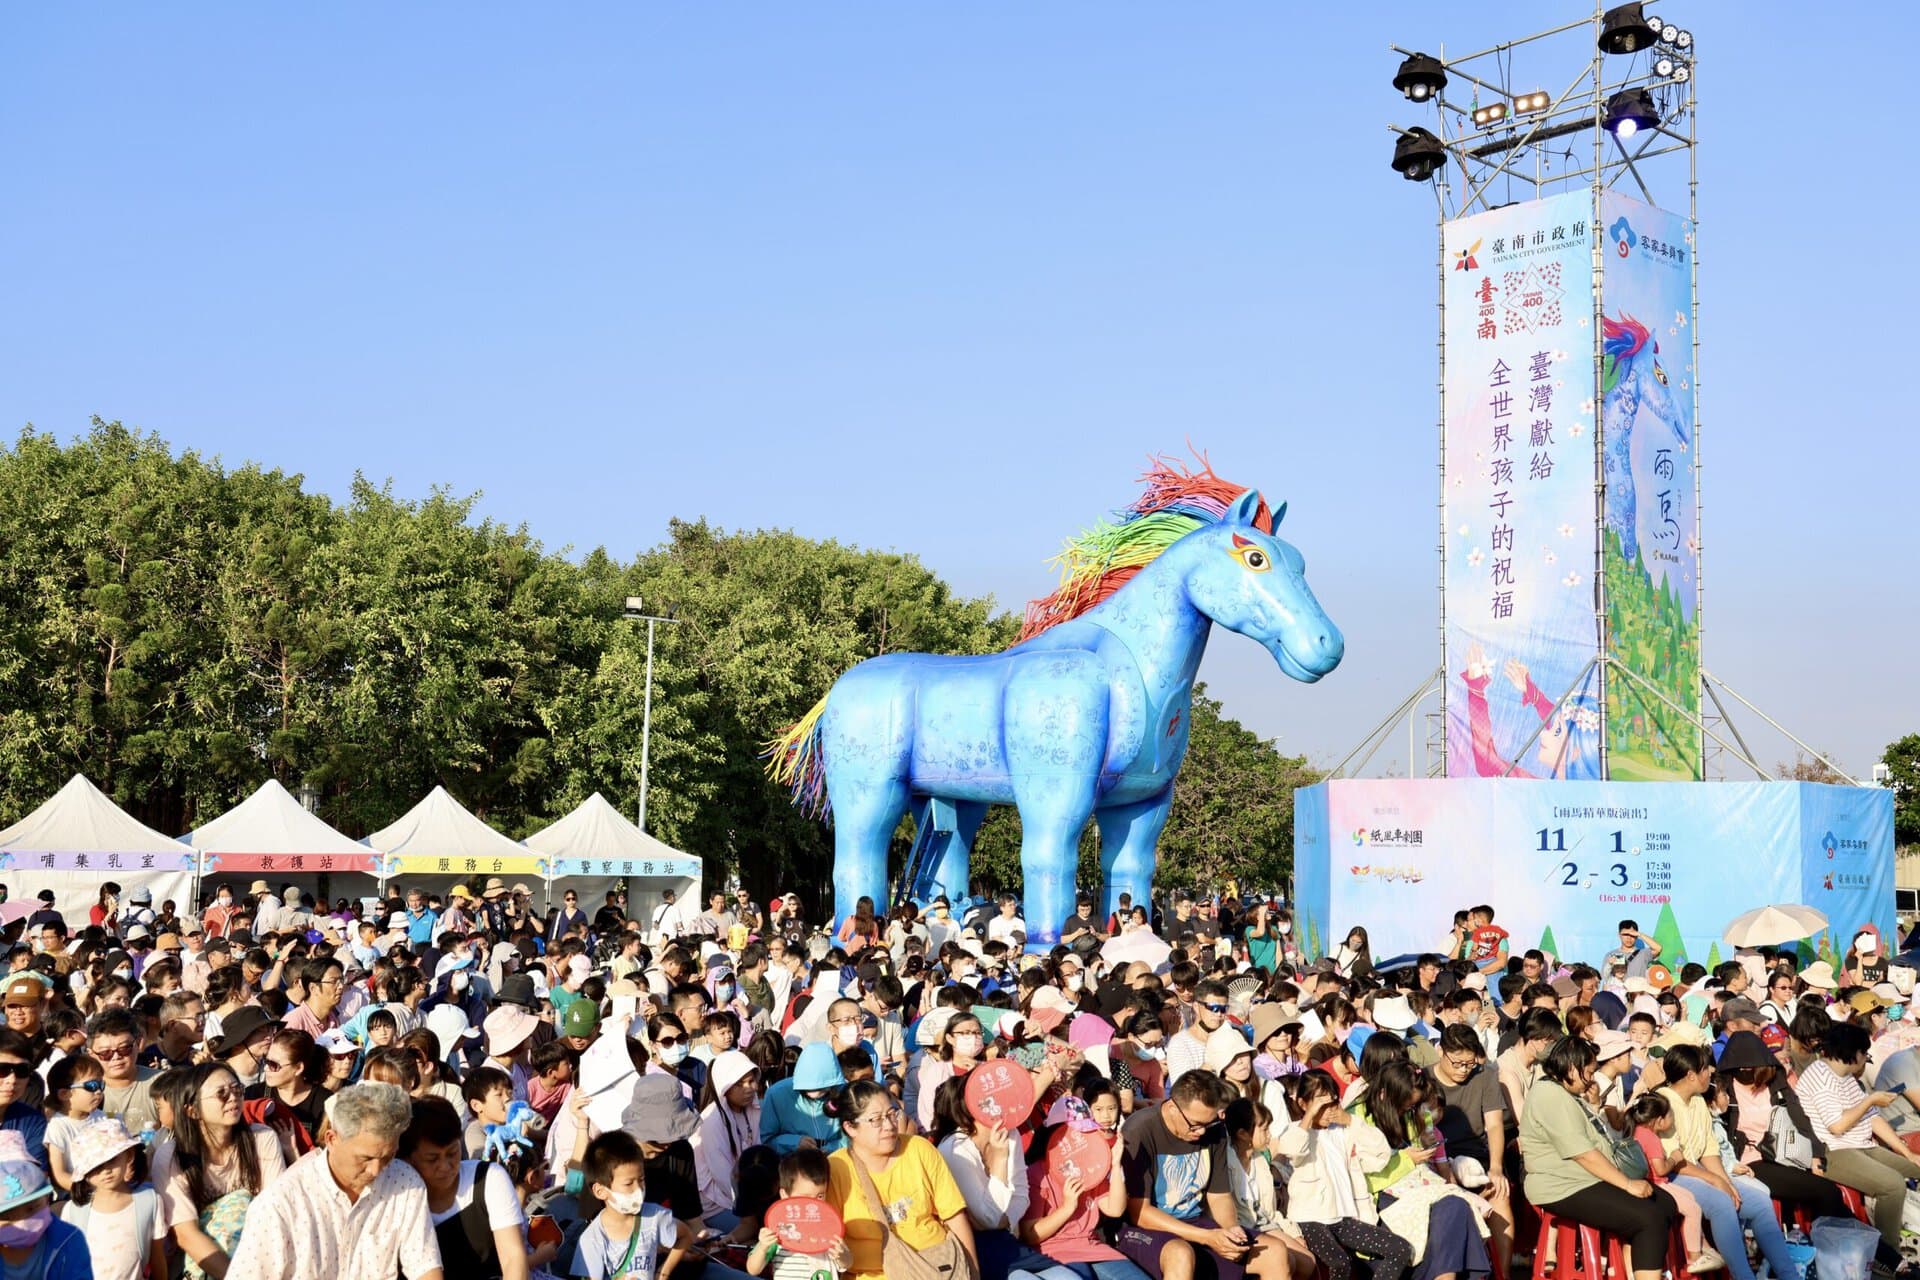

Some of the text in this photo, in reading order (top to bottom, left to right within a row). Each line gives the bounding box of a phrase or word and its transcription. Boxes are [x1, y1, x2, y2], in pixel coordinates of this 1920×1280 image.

[1492, 220, 1585, 254] 臺南市政府
[1493, 239, 1585, 264] TAINAN CITY GOVERNMENT
[1522, 297, 1543, 308] 400
[1479, 307, 1495, 317] 400
[1528, 351, 1554, 481] 臺灣獻給
[1489, 358, 1515, 619] 全世界孩子的祝福
[1610, 830, 1627, 853] 1
[1645, 832, 1671, 841] 19:00
[1645, 842, 1671, 851] 20:00
[40, 852, 155, 868] 哺集乳室
[260, 855, 333, 870] 救護站
[438, 857, 504, 872] 服務台
[580, 860, 675, 874] 警察服務站
[1561, 862, 1579, 886] 2
[1610, 863, 1629, 887] 3
[1646, 861, 1671, 870] 17:30
[1646, 871, 1671, 880] 19:00
[1646, 881, 1672, 890] 20:00
